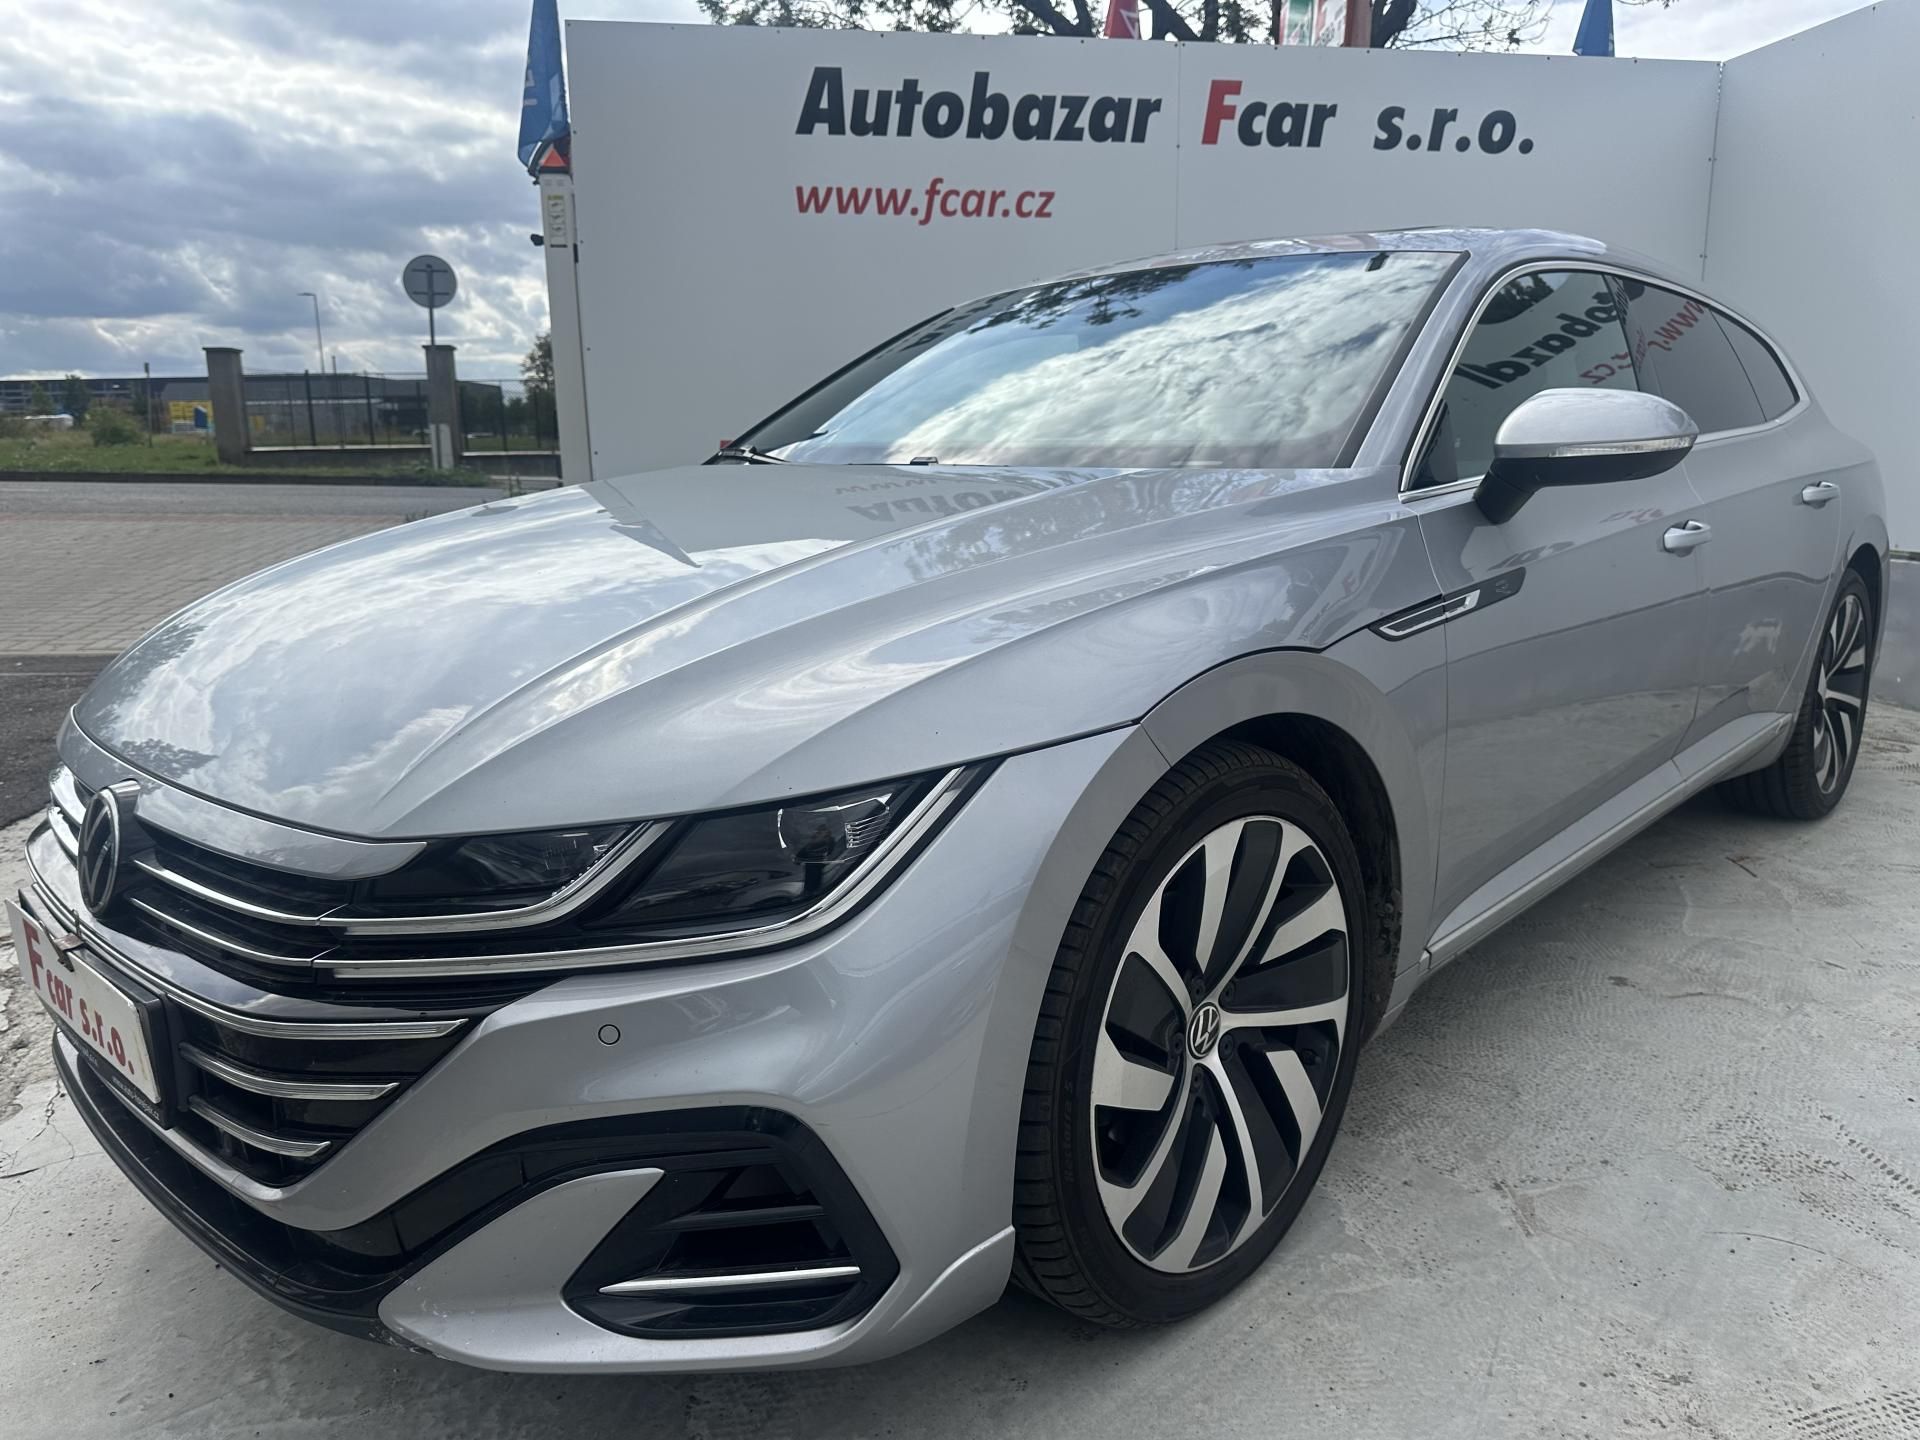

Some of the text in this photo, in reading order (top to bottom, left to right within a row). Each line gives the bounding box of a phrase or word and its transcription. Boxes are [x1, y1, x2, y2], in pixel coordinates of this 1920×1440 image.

[795, 66, 1534, 155] Autobazar Fcar s.r.o.
[795, 177, 1054, 225] www.fcar.cz
[80, 998, 136, 1076] s.r.o.
